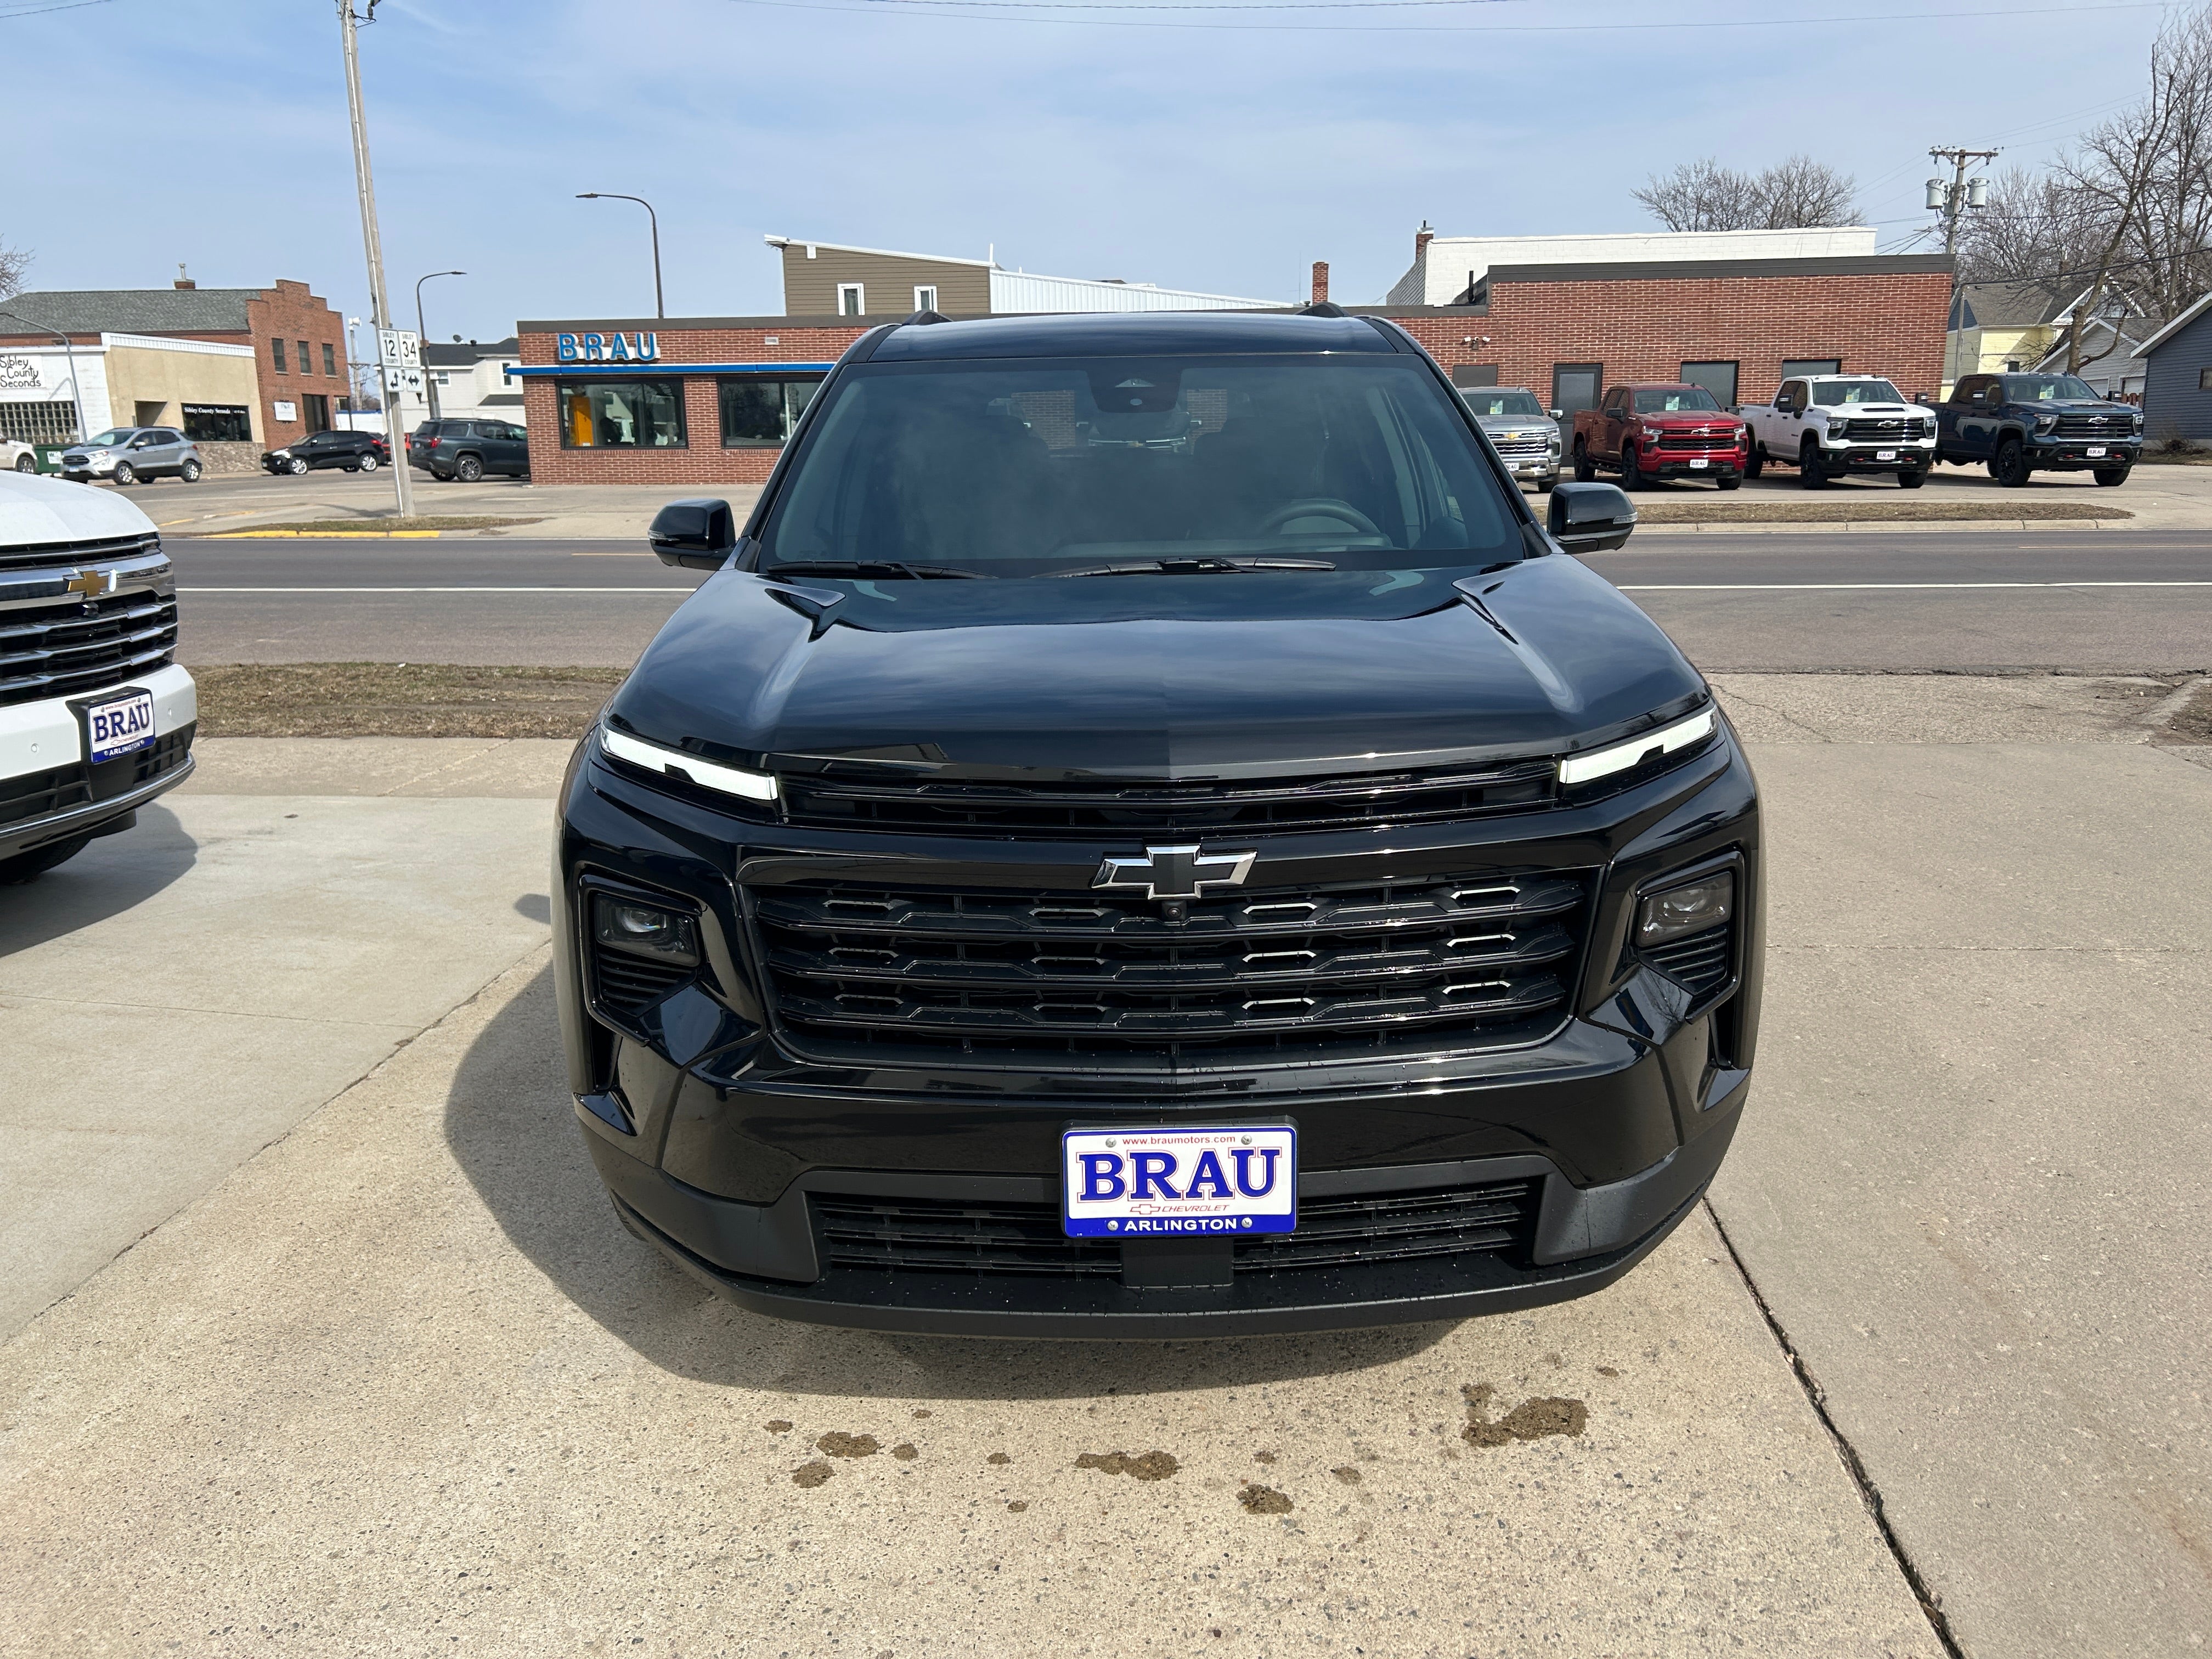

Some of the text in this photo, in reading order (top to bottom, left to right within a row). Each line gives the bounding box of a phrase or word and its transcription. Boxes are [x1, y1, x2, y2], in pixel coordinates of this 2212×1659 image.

[385, 340, 396, 357] 12
[403, 341, 416, 358] 34
[558, 332, 657, 362] BRAU
[0, 355, 29, 370] Sibley
[7, 365, 38, 380] County
[0, 375, 41, 387] Seconds
[92, 702, 149, 744] BRAU
[109, 741, 140, 756] ARLINGTON
[1122, 1136, 1235, 1145] www.braumotors.com
[1076, 1147, 1282, 1203] BRAU
[1124, 1218, 1237, 1232] ARLINGTON
